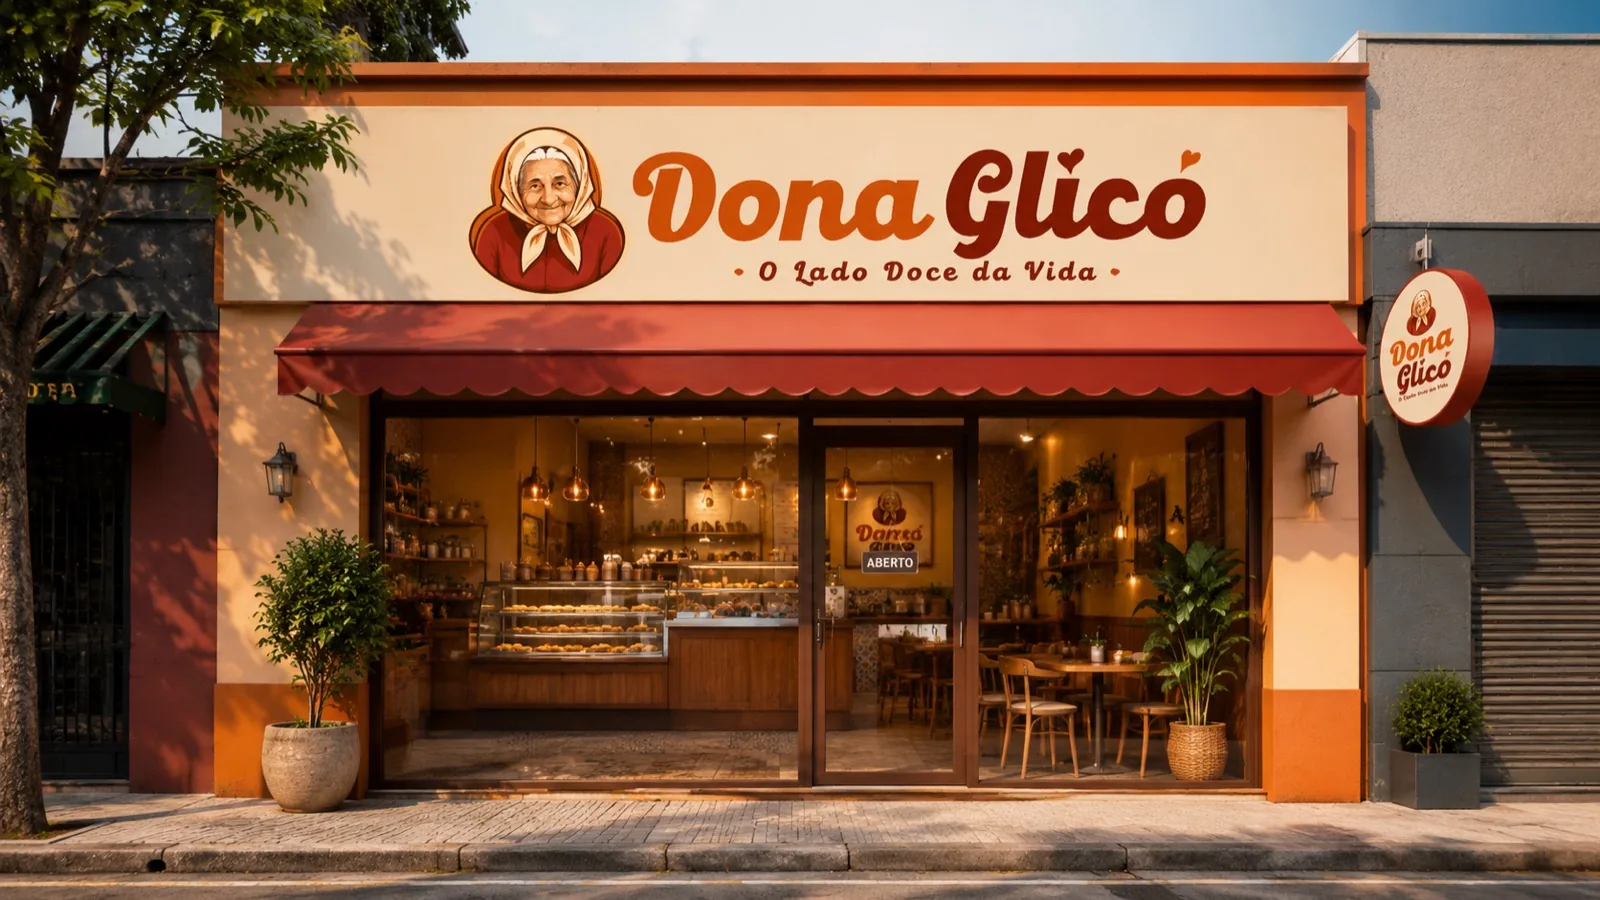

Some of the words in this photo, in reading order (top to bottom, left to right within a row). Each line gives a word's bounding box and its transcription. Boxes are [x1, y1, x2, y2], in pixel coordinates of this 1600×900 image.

[633, 151, 935, 243] Dona
[945, 148, 1207, 259] Glicó
[758, 261, 778, 282] O
[794, 261, 868, 287] Lado
[883, 261, 959, 282] Doce
[972, 261, 1012, 282] da
[1025, 260, 1097, 282] Vida
[1390, 328, 1454, 367] Dona
[1398, 352, 1452, 396] Glicó
[866, 557, 914, 569] ABERTO
